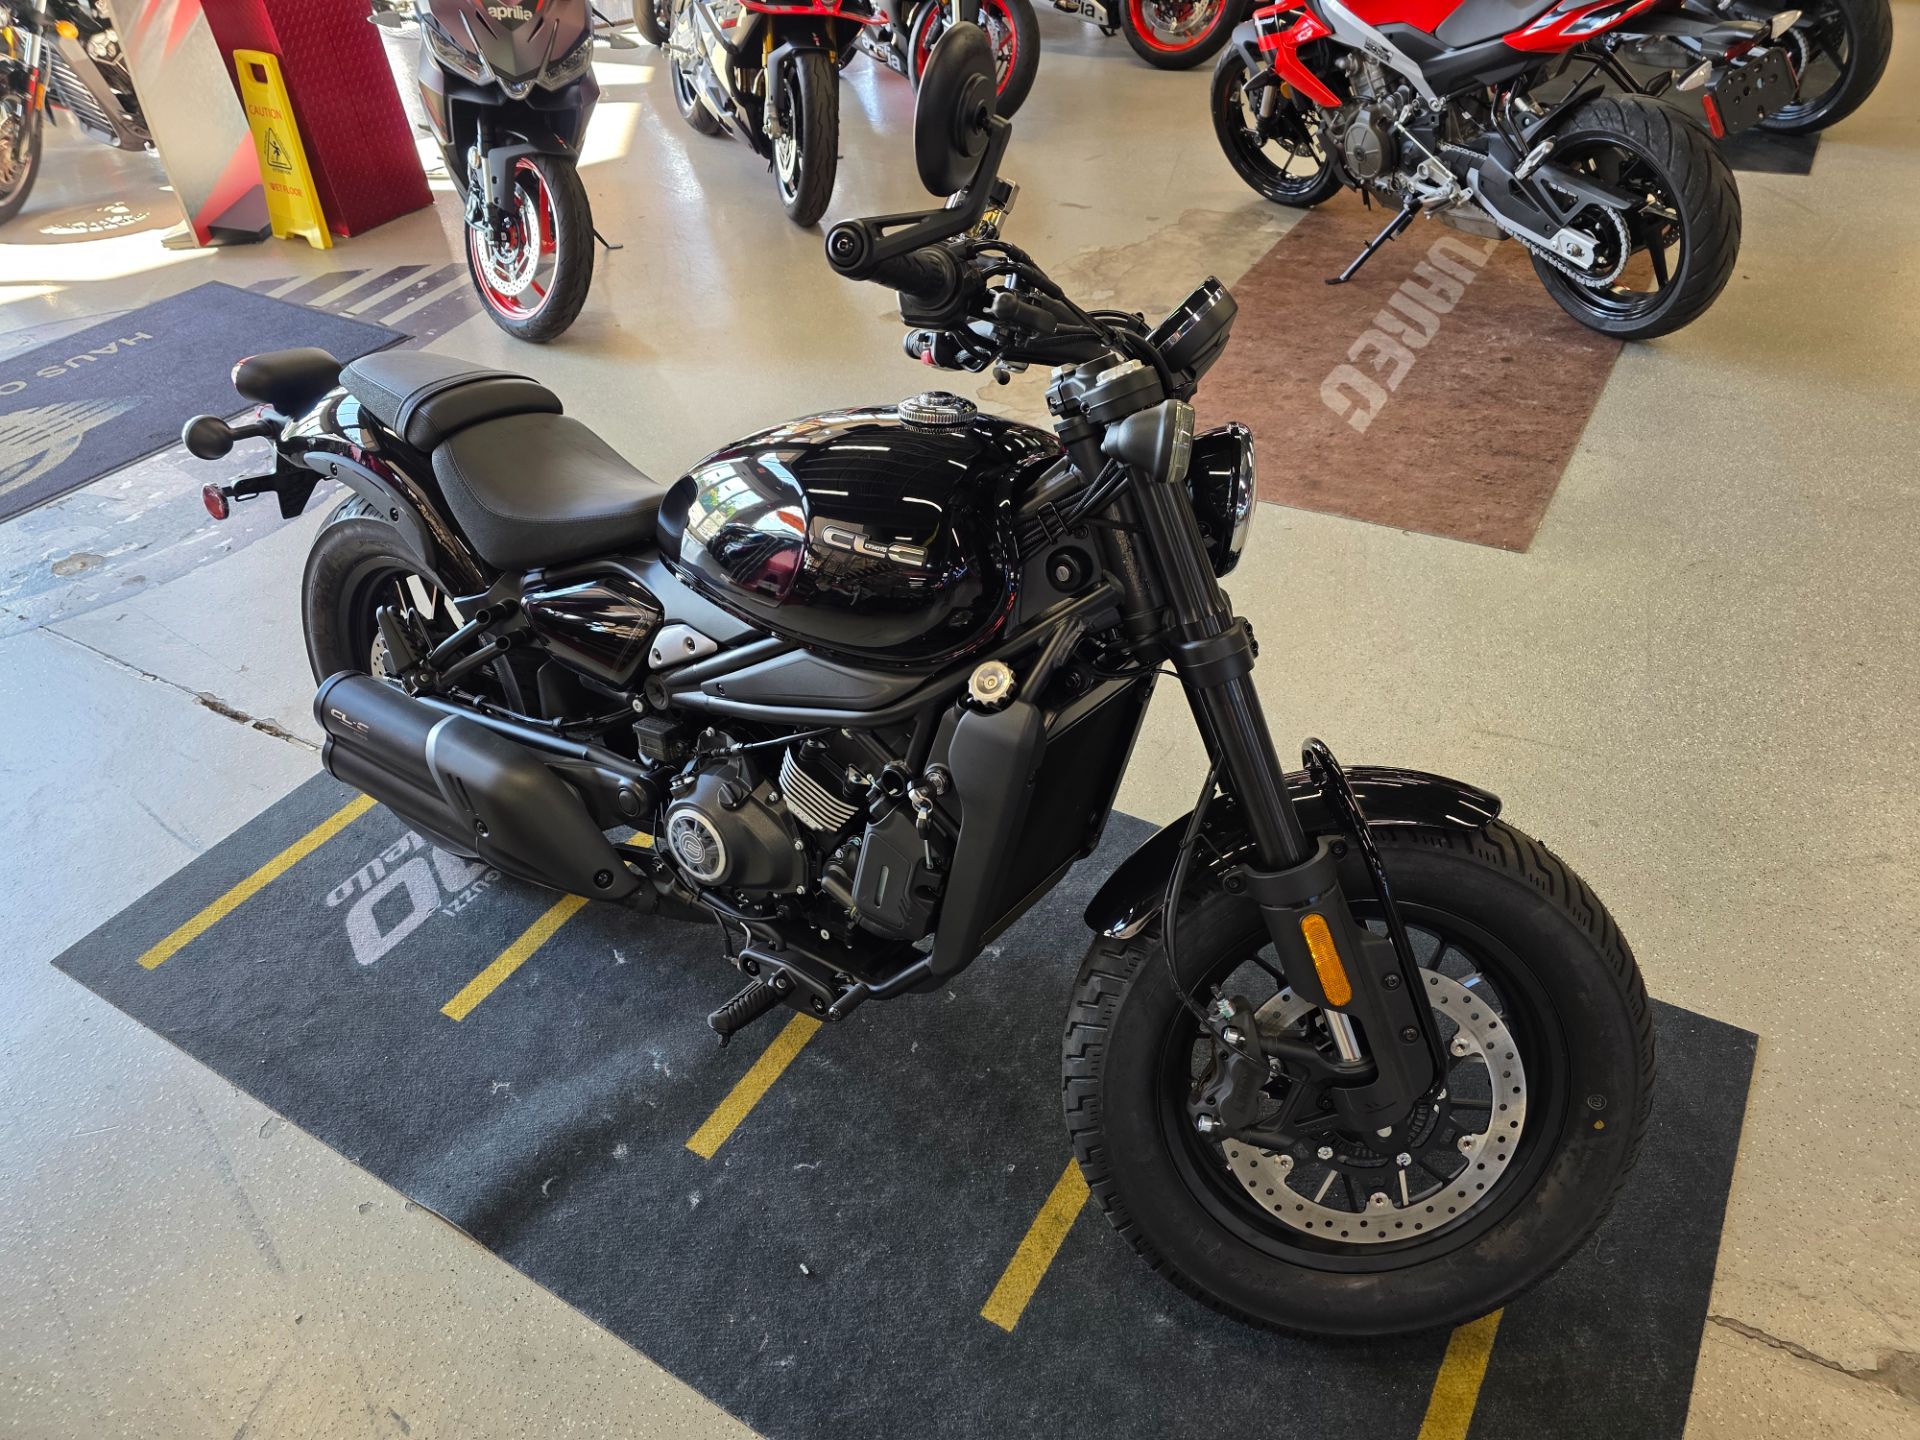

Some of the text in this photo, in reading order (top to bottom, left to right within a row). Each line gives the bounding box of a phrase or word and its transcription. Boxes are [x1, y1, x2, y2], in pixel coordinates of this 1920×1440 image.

[487, 5, 533, 21] aprilia
[248, 105, 282, 120] CAUTION
[35, 331, 153, 378] HAUS
[440, 869, 501, 918] GUZZI
